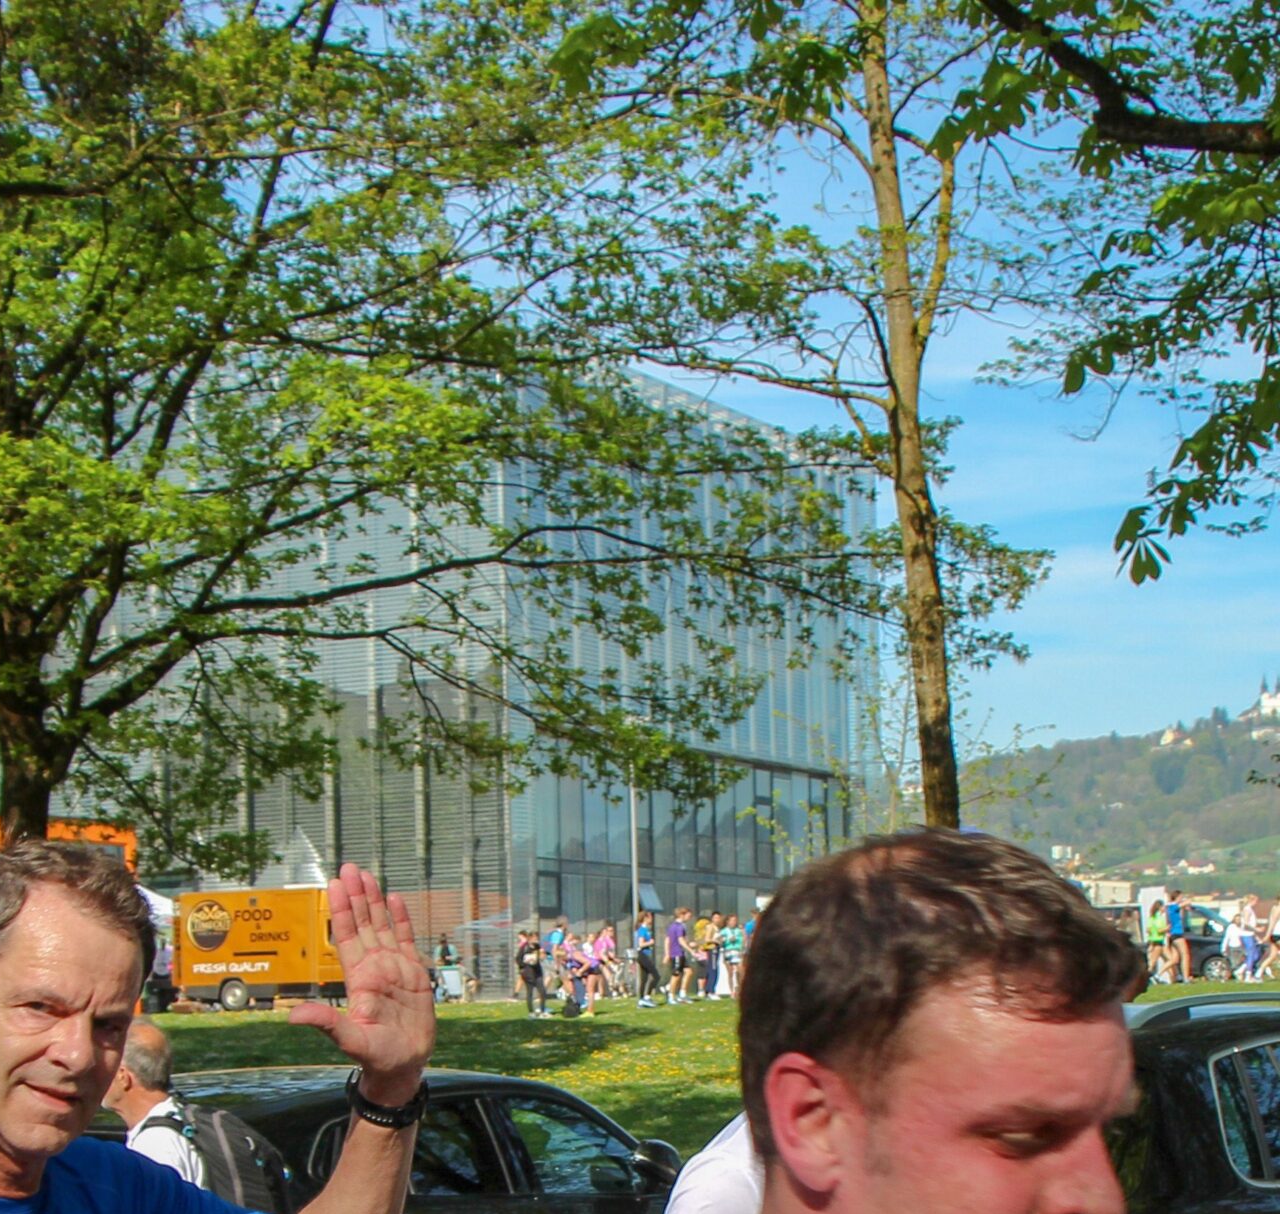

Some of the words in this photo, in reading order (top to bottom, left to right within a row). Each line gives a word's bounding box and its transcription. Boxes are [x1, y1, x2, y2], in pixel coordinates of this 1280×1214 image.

[234, 909, 273, 921] FOOD
[249, 930, 290, 942] DRINKS
[192, 962, 227, 974] FRESH
[228, 961, 271, 973] QUALITY
